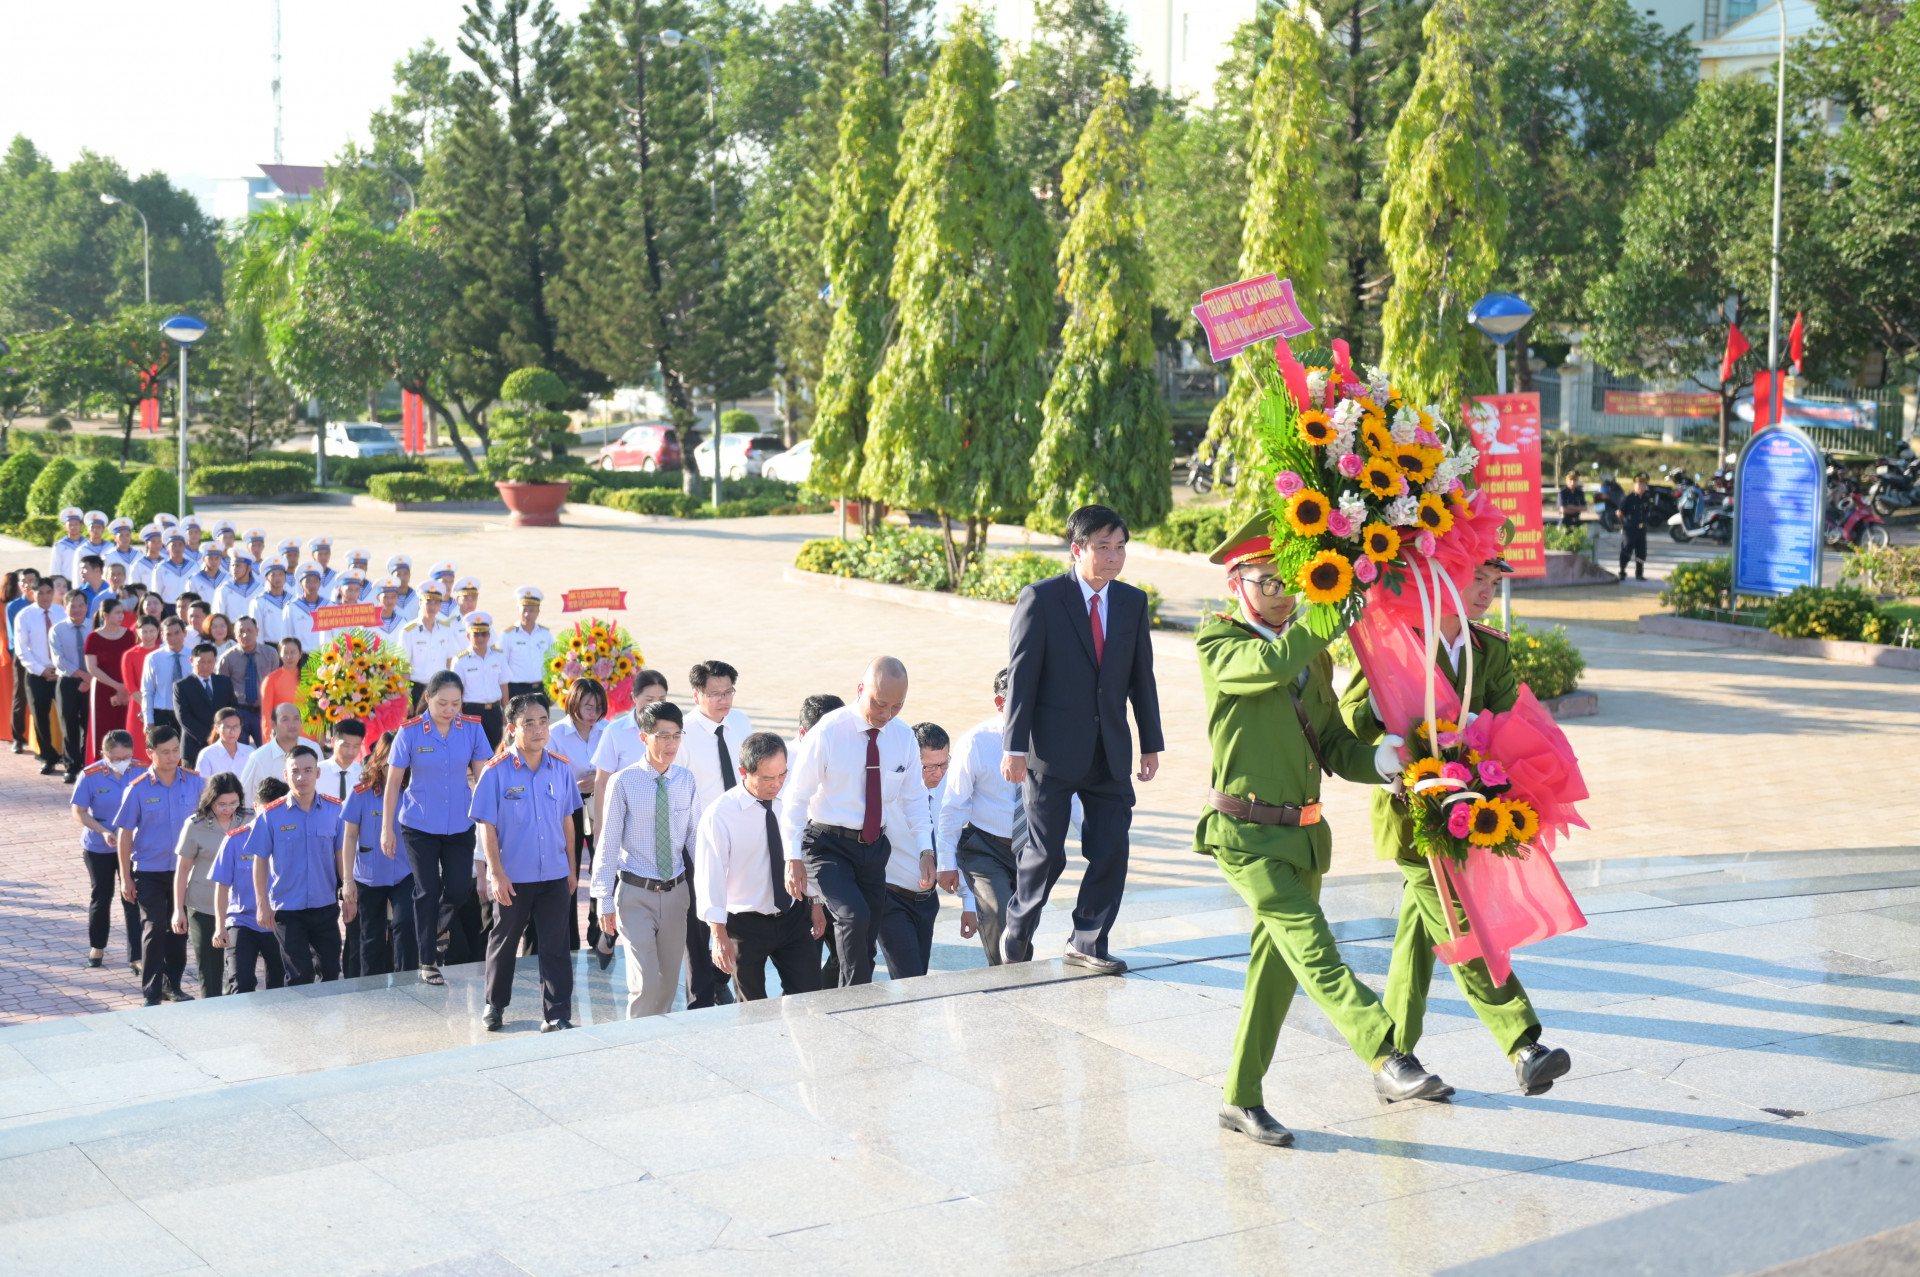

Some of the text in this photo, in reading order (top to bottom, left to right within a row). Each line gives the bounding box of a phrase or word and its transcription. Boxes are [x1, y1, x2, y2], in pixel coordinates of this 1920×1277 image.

[1204, 294, 1234, 318] THÀNH
[1243, 286, 1262, 306] CAM
[1258, 280, 1282, 302] RANH
[1502, 463, 1522, 478] TỊCH
[1490, 479, 1506, 493] CHÍ
[1507, 480, 1530, 492] MINH
[1525, 548, 1537, 560] TA
